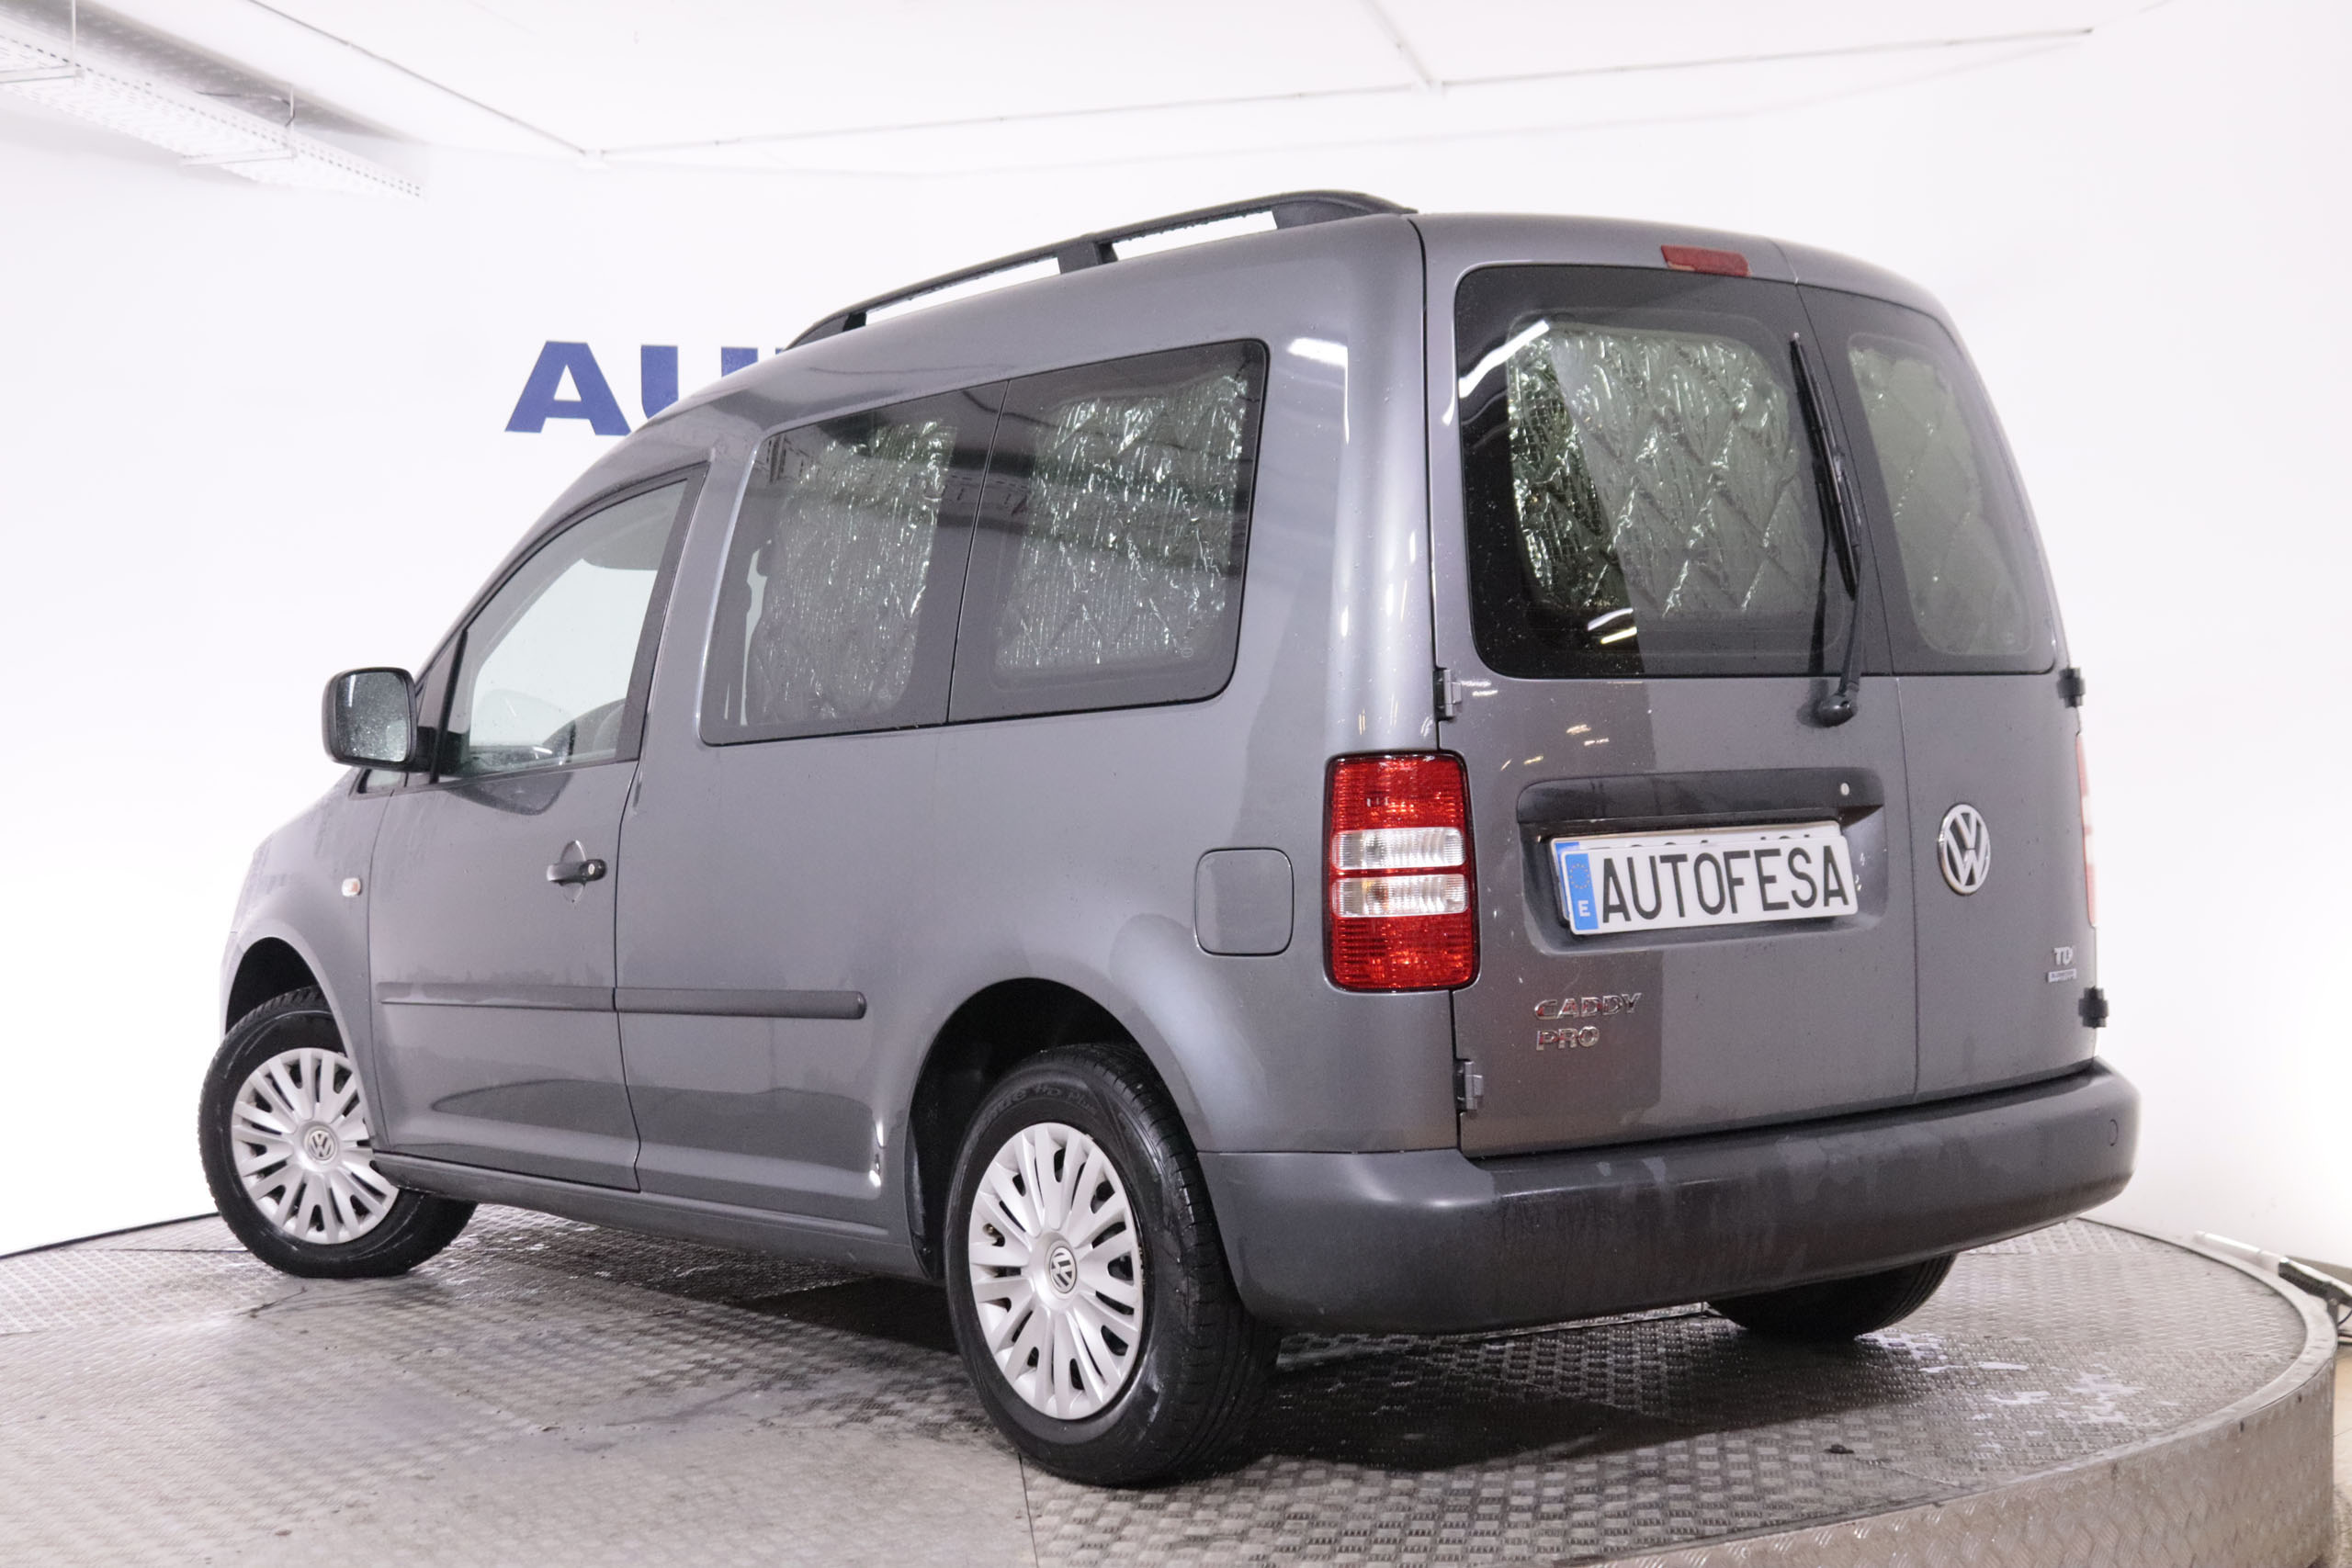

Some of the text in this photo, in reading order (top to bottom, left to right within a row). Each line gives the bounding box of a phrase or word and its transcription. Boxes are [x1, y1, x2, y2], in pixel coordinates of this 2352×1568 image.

[1602, 844, 1849, 924] AUTOFESA
[1577, 899, 1591, 918] E
[1534, 992, 1643, 1021] CADDY
[1535, 1025, 1600, 1051] PRO
